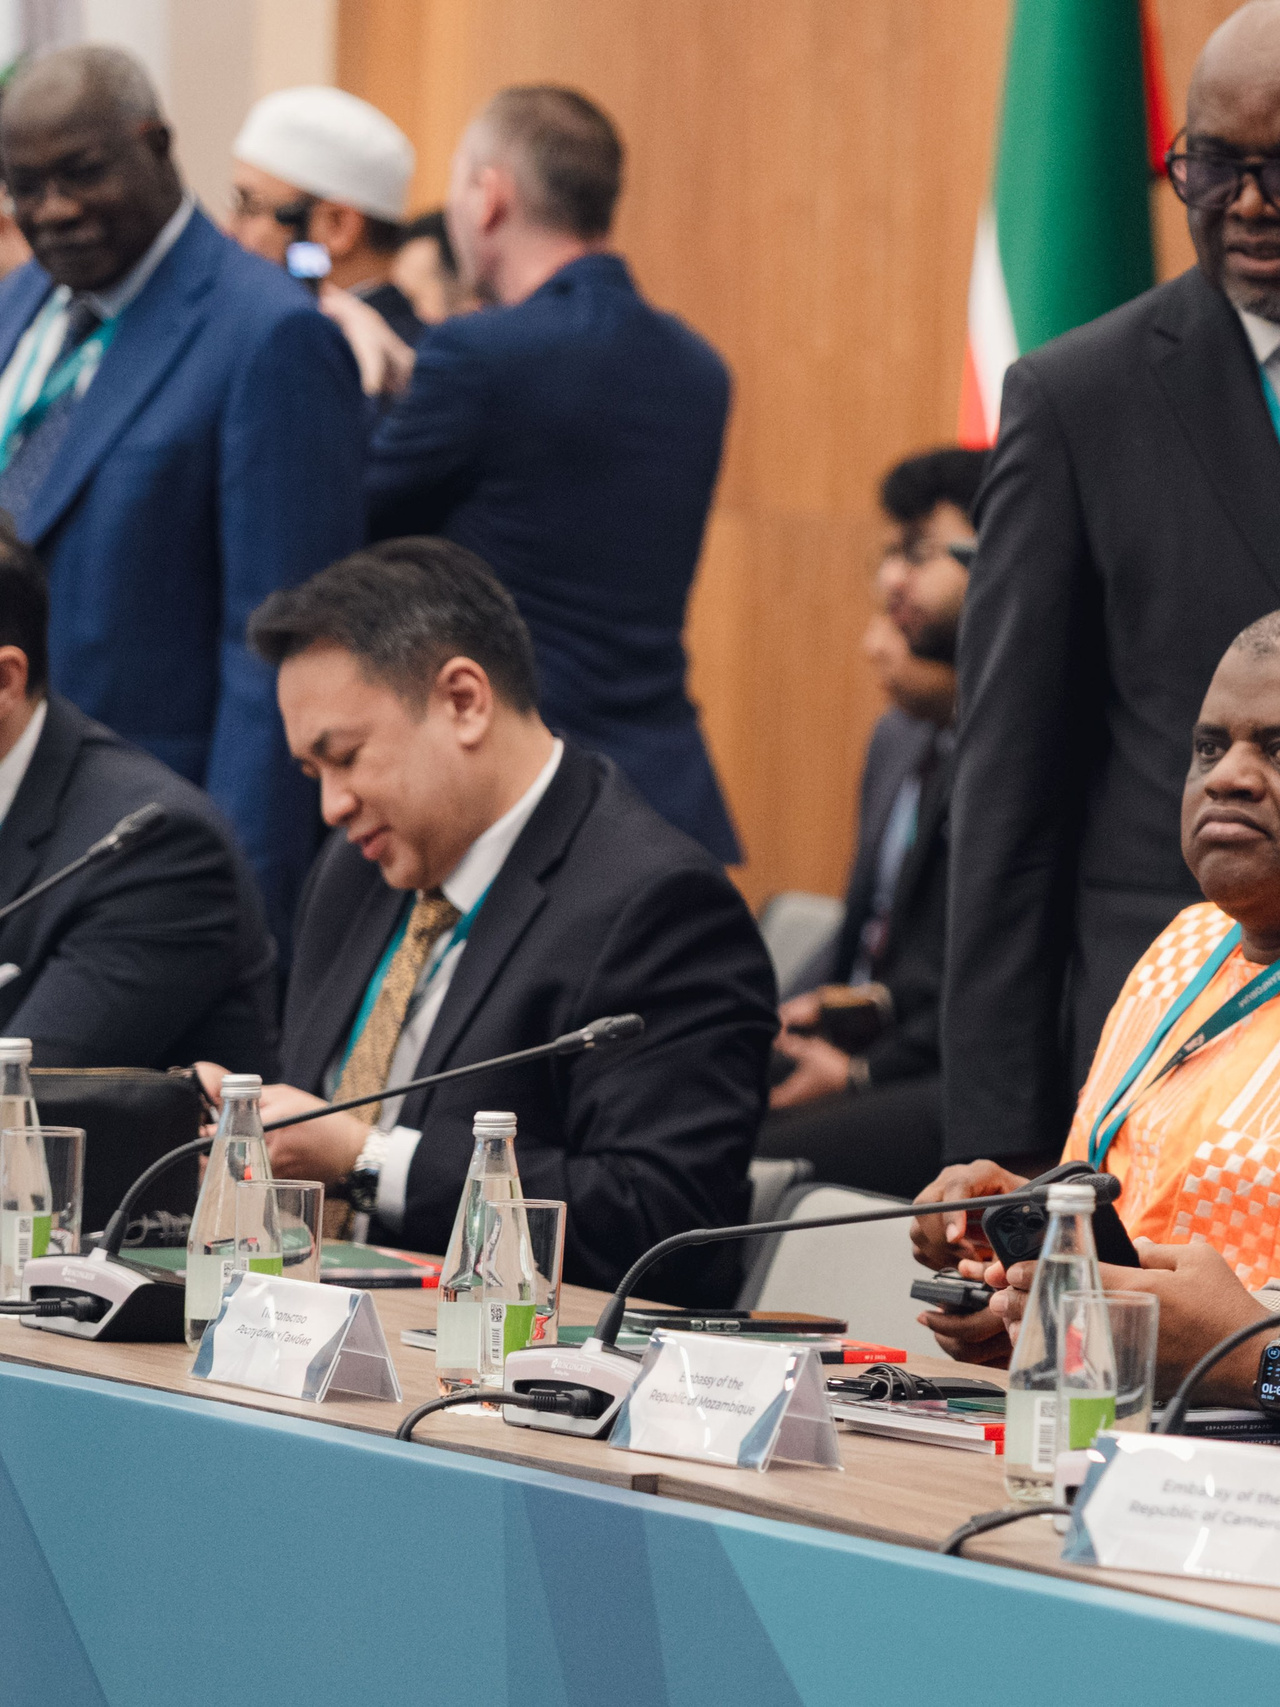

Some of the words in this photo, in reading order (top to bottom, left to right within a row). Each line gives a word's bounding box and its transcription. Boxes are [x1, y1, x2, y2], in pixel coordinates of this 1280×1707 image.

[280, 1330, 312, 1347] Гамбия
[716, 1375, 729, 1388] of
[727, 1376, 744, 1391] the
[698, 1396, 755, 1416] Mozambique
[1236, 1488, 1257, 1502] of
[1128, 1499, 1199, 1521] Republic
[1202, 1507, 1221, 1523] of
